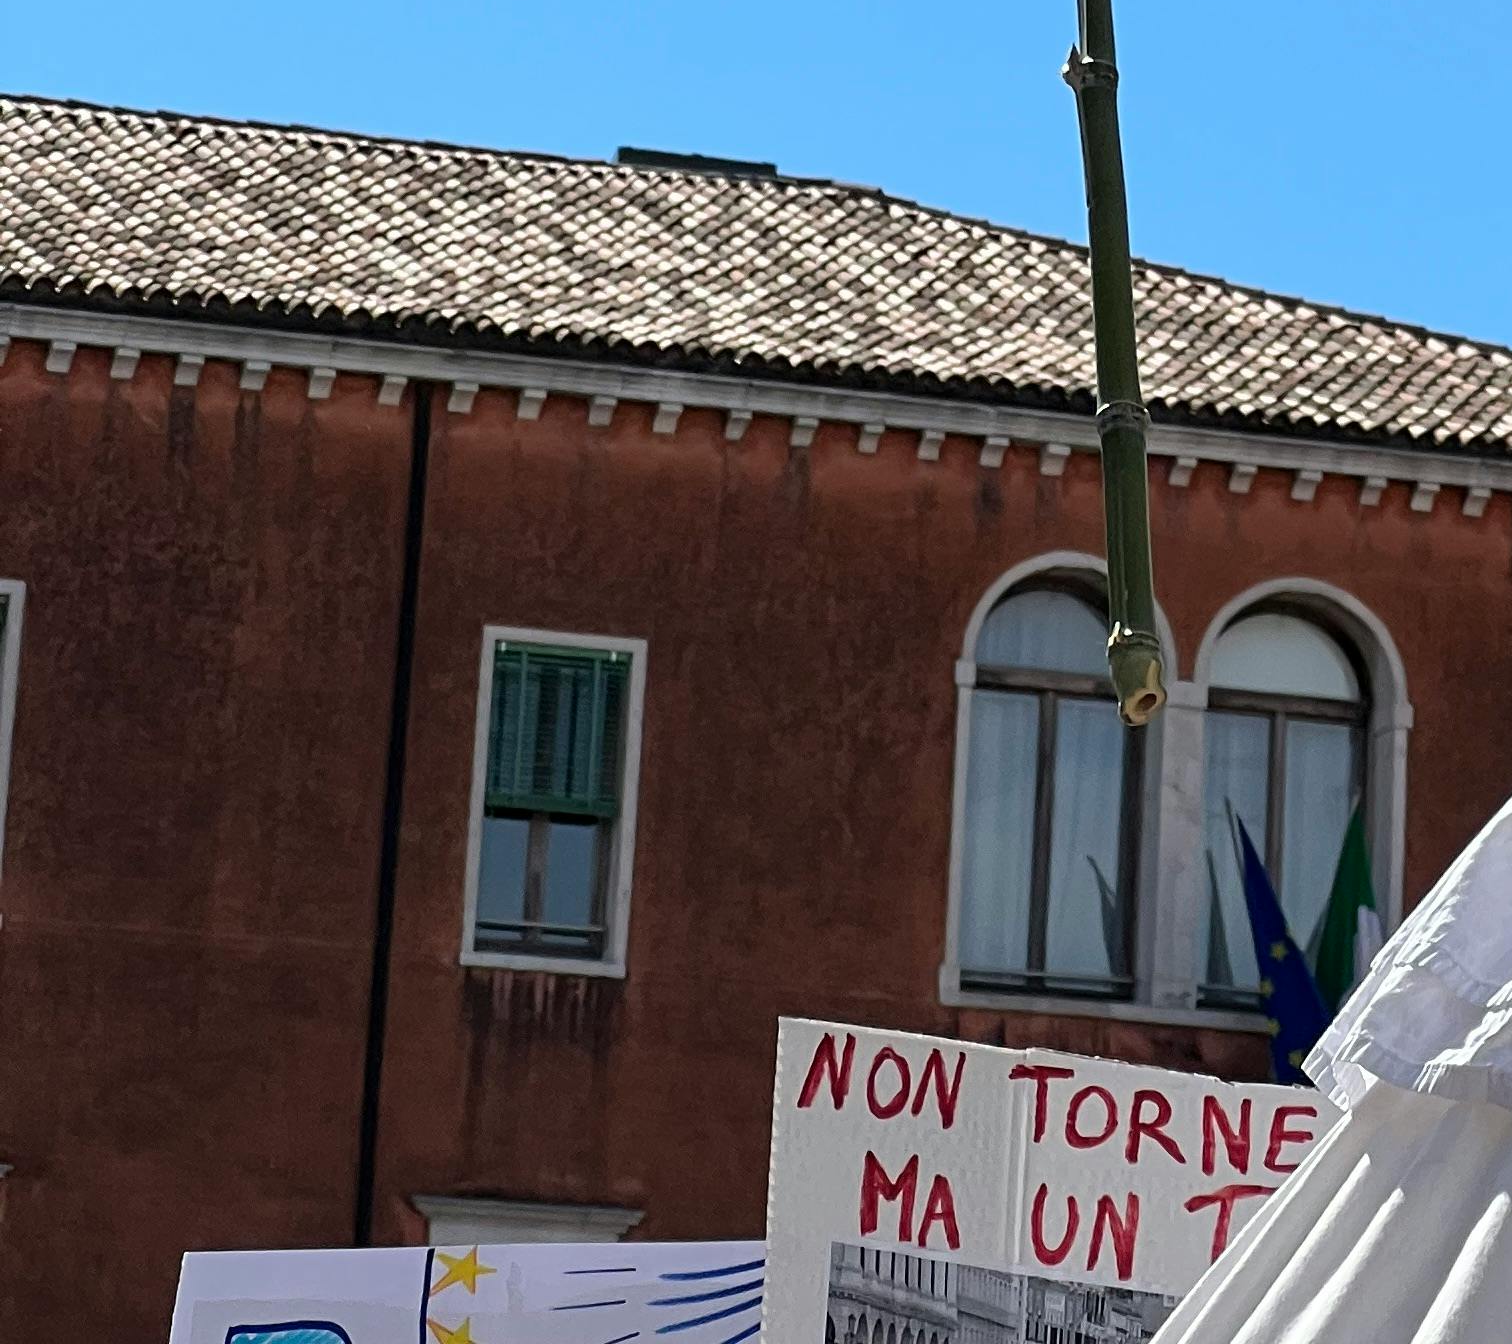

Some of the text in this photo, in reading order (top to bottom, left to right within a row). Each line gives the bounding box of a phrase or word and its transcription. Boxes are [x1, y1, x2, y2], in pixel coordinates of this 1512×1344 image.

[797, 1032, 965, 1129] NON
[859, 1151, 960, 1249] MA
[1031, 1184, 1140, 1281] UN
